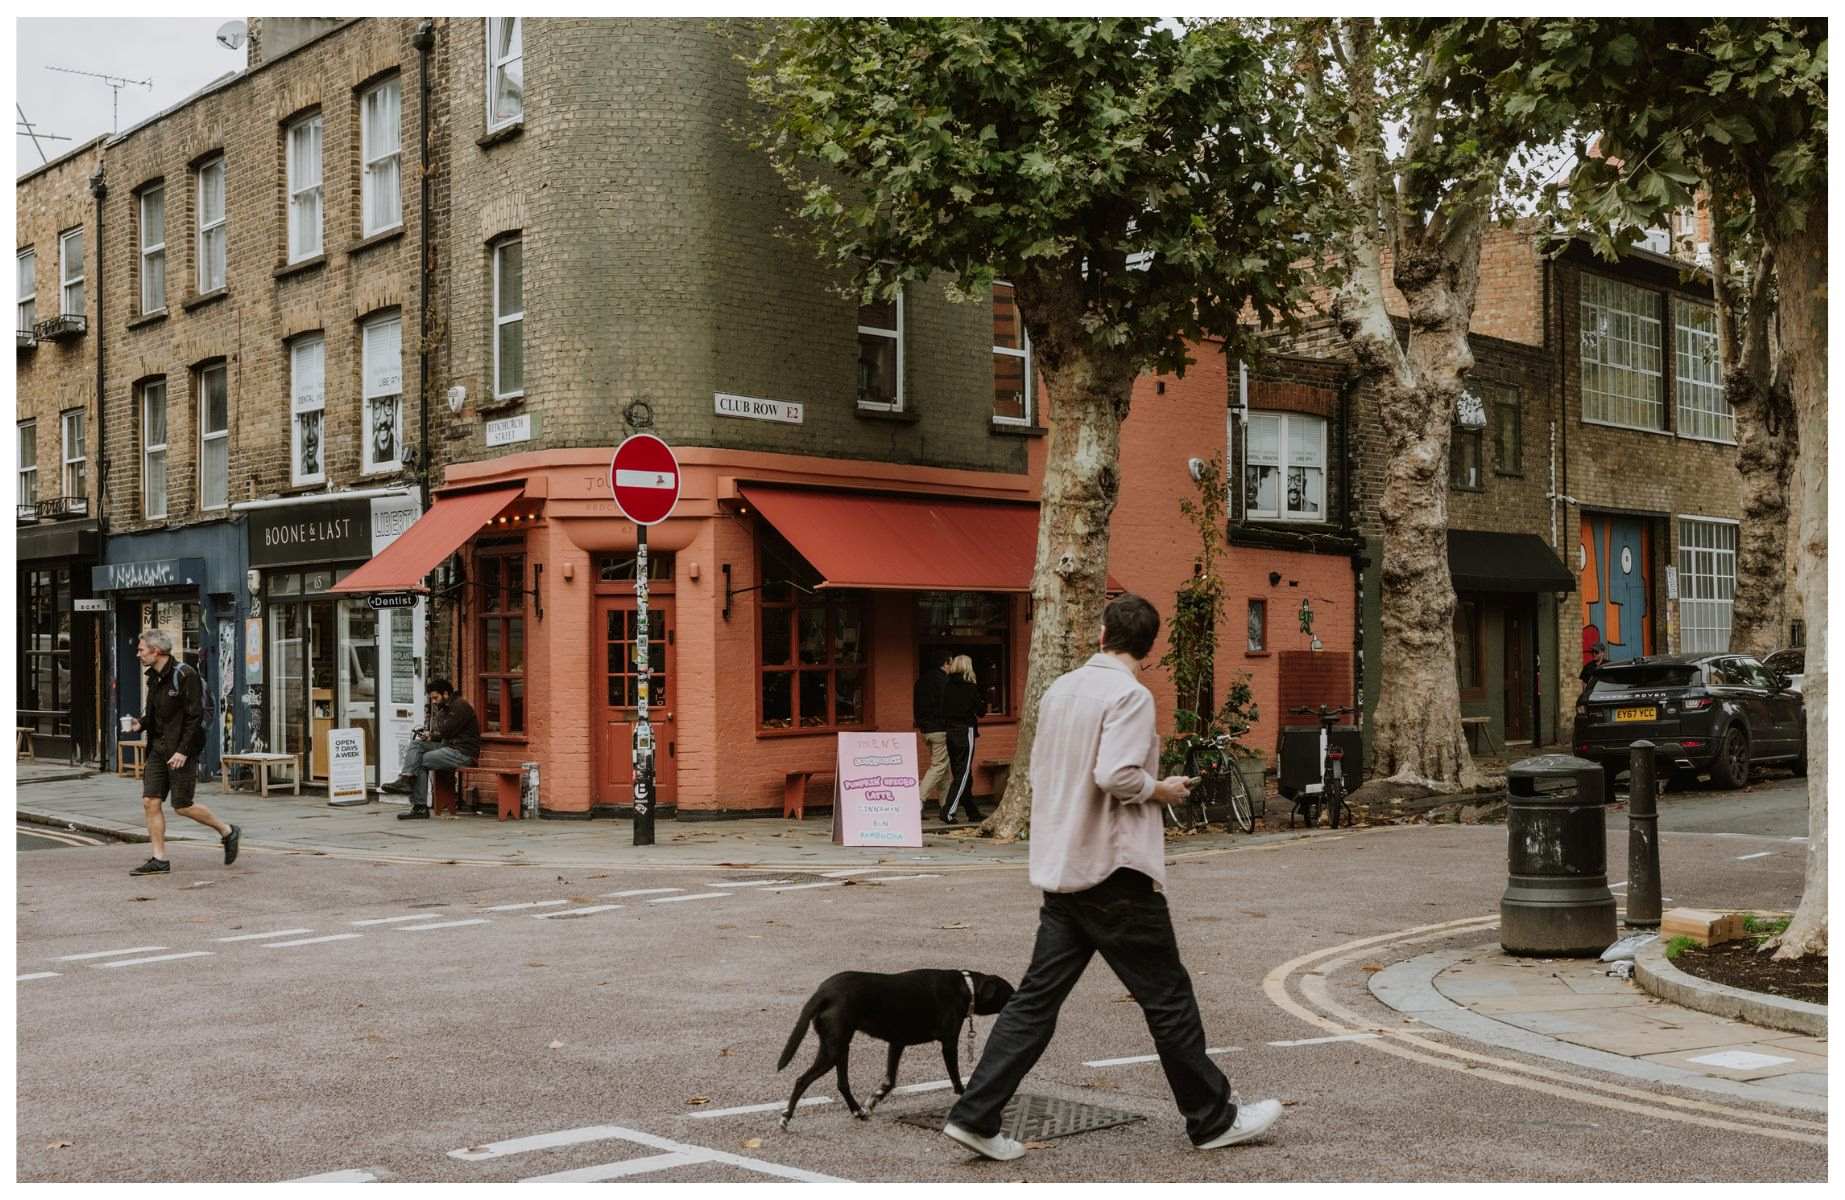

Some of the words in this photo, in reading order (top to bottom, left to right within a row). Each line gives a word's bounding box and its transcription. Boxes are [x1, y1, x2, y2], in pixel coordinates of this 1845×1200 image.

[720, 398, 750, 413] CLUB
[753, 403, 778, 416] ROW
[786, 406, 799, 419] E2
[265, 524, 306, 546] BOONE
[309, 523, 316, 542] &
[319, 518, 351, 541] LAST
[375, 596, 412, 606] Dentist
[1616, 710, 1637, 719] EY67
